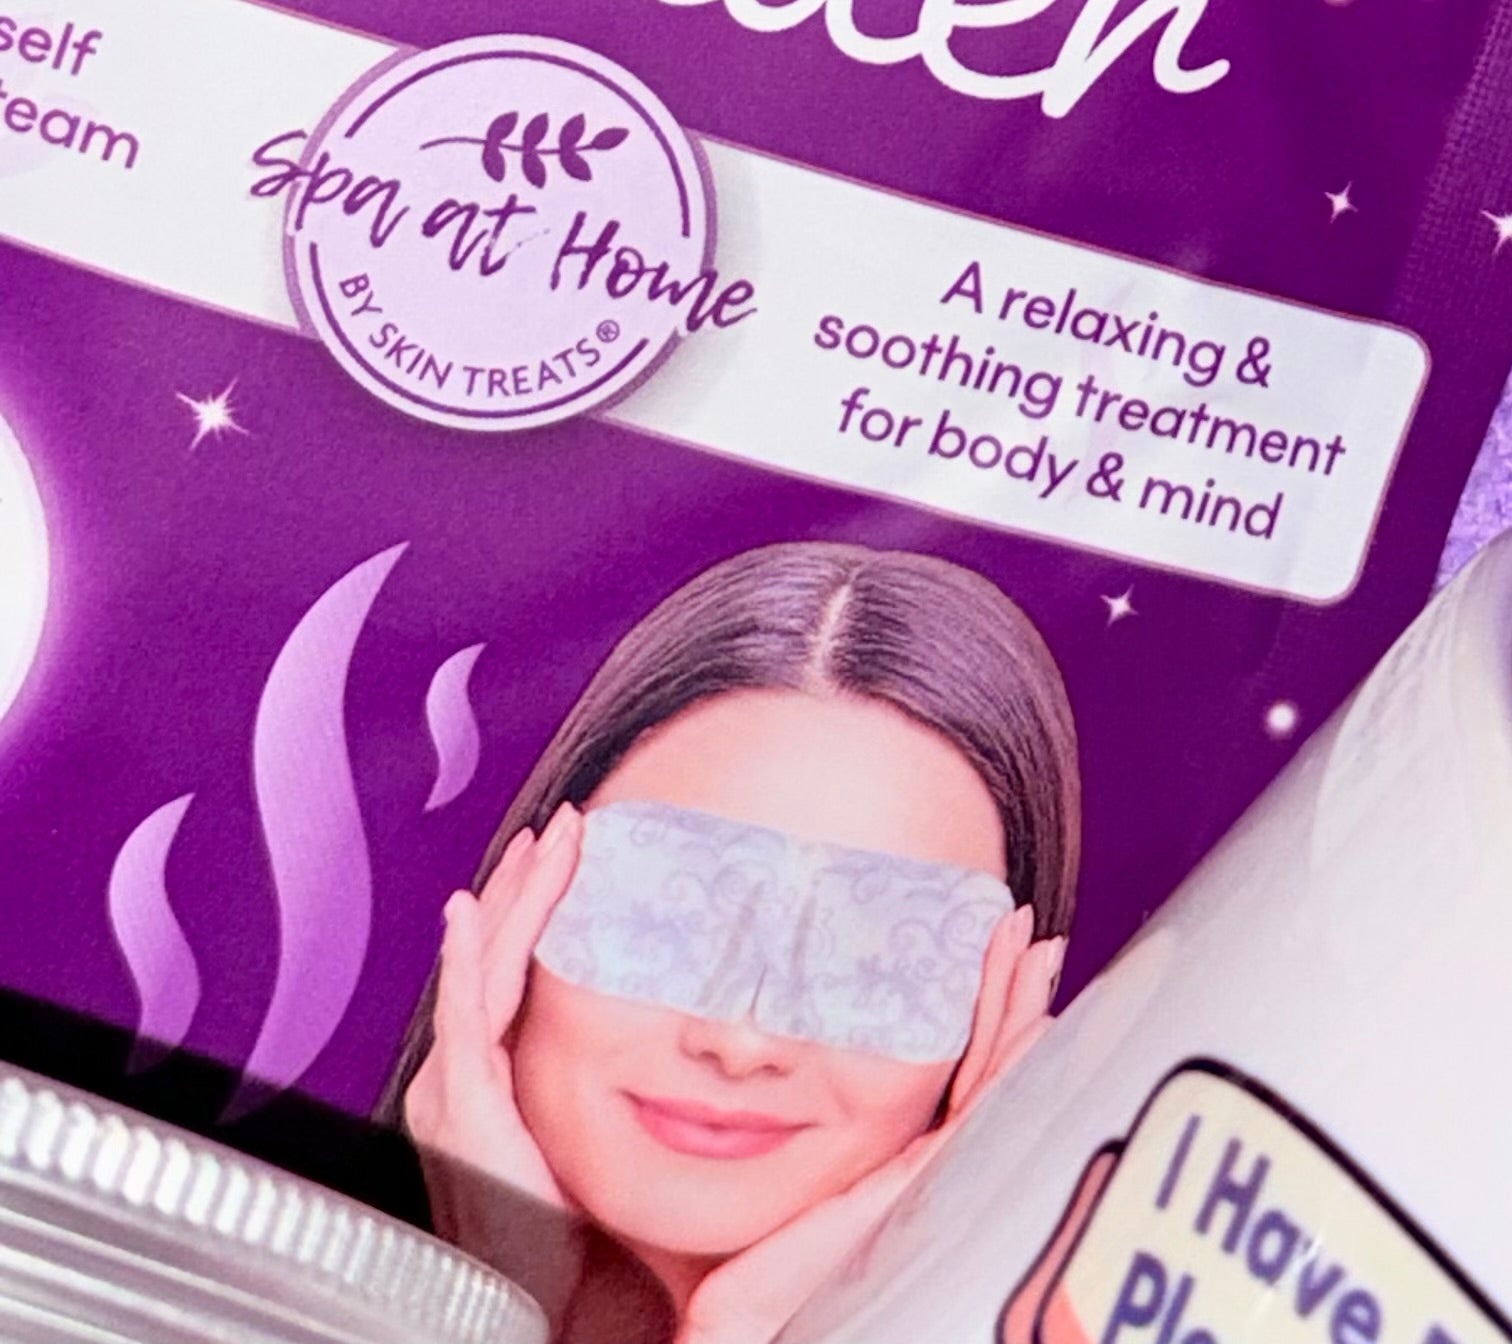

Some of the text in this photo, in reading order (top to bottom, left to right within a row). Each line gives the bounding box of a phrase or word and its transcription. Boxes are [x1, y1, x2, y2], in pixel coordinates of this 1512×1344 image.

[250, 129, 758, 333] Spa at Home
[339, 273, 383, 317] BY
[369, 323, 453, 389] SKIN
[814, 315, 1346, 475] soothing treatment
[940, 261, 1271, 387] A relaxing &
[838, 387, 1284, 539] for body & mind
[1154, 1114, 1381, 1344] I Have
